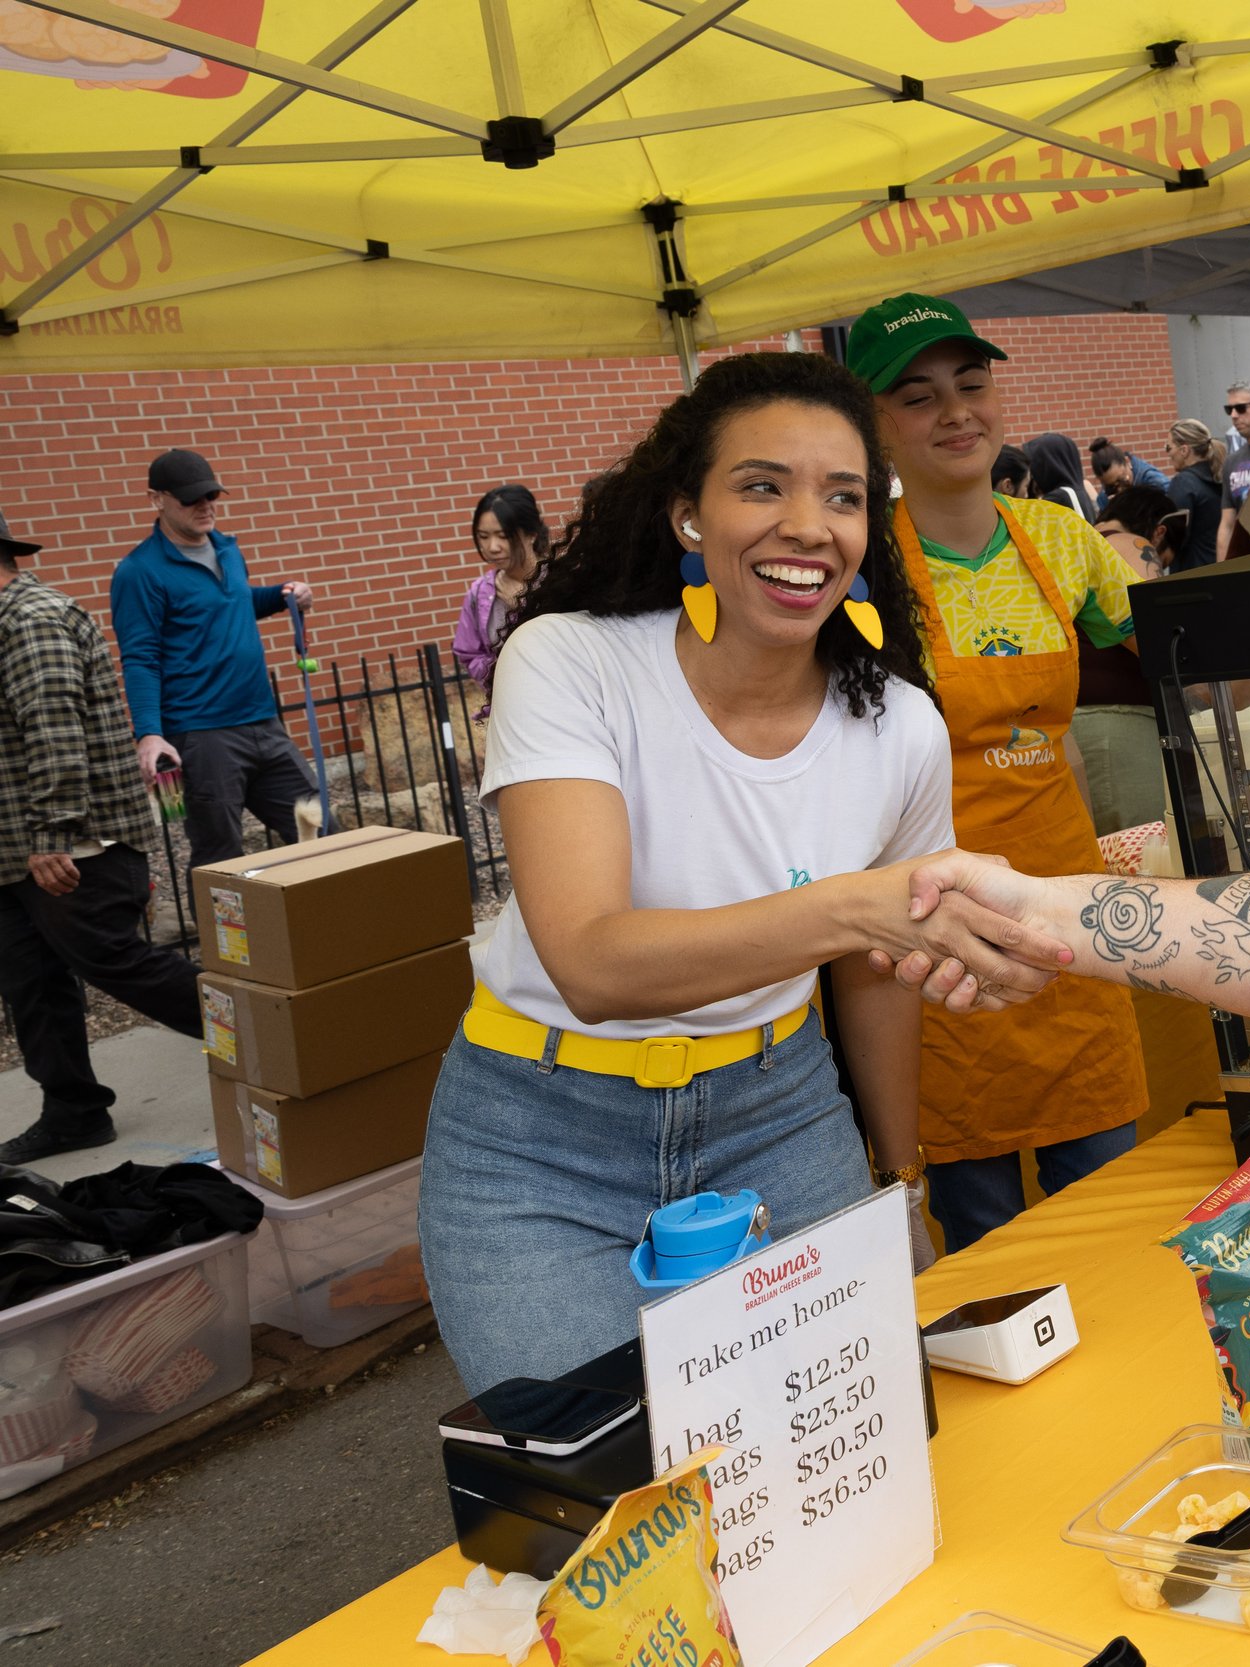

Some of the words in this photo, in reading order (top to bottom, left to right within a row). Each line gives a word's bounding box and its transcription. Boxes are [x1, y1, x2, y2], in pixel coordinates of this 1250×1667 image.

[742, 1244, 821, 1295] Bruna's
[745, 1288, 778, 1312] BRAZILIAN
[780, 1276, 801, 1294] CHEESE
[802, 1266, 822, 1282] BREAD
[678, 1340, 743, 1387] Take
[749, 1317, 788, 1352] me
[792, 1279, 867, 1329] home-
[660, 1444, 675, 1473] 1
[683, 1408, 743, 1456] bag
[785, 1336, 870, 1404] $12.50
[713, 1445, 762, 1489] ags
[790, 1375, 876, 1444] $23.50
[714, 1487, 769, 1534] ags
[797, 1412, 884, 1484] $30.50
[801, 1455, 888, 1527] $36.50
[565, 1482, 701, 1610] Bruna's
[615, 1608, 657, 1661] BRAZILIAN
[625, 1603, 687, 1667] EESE
